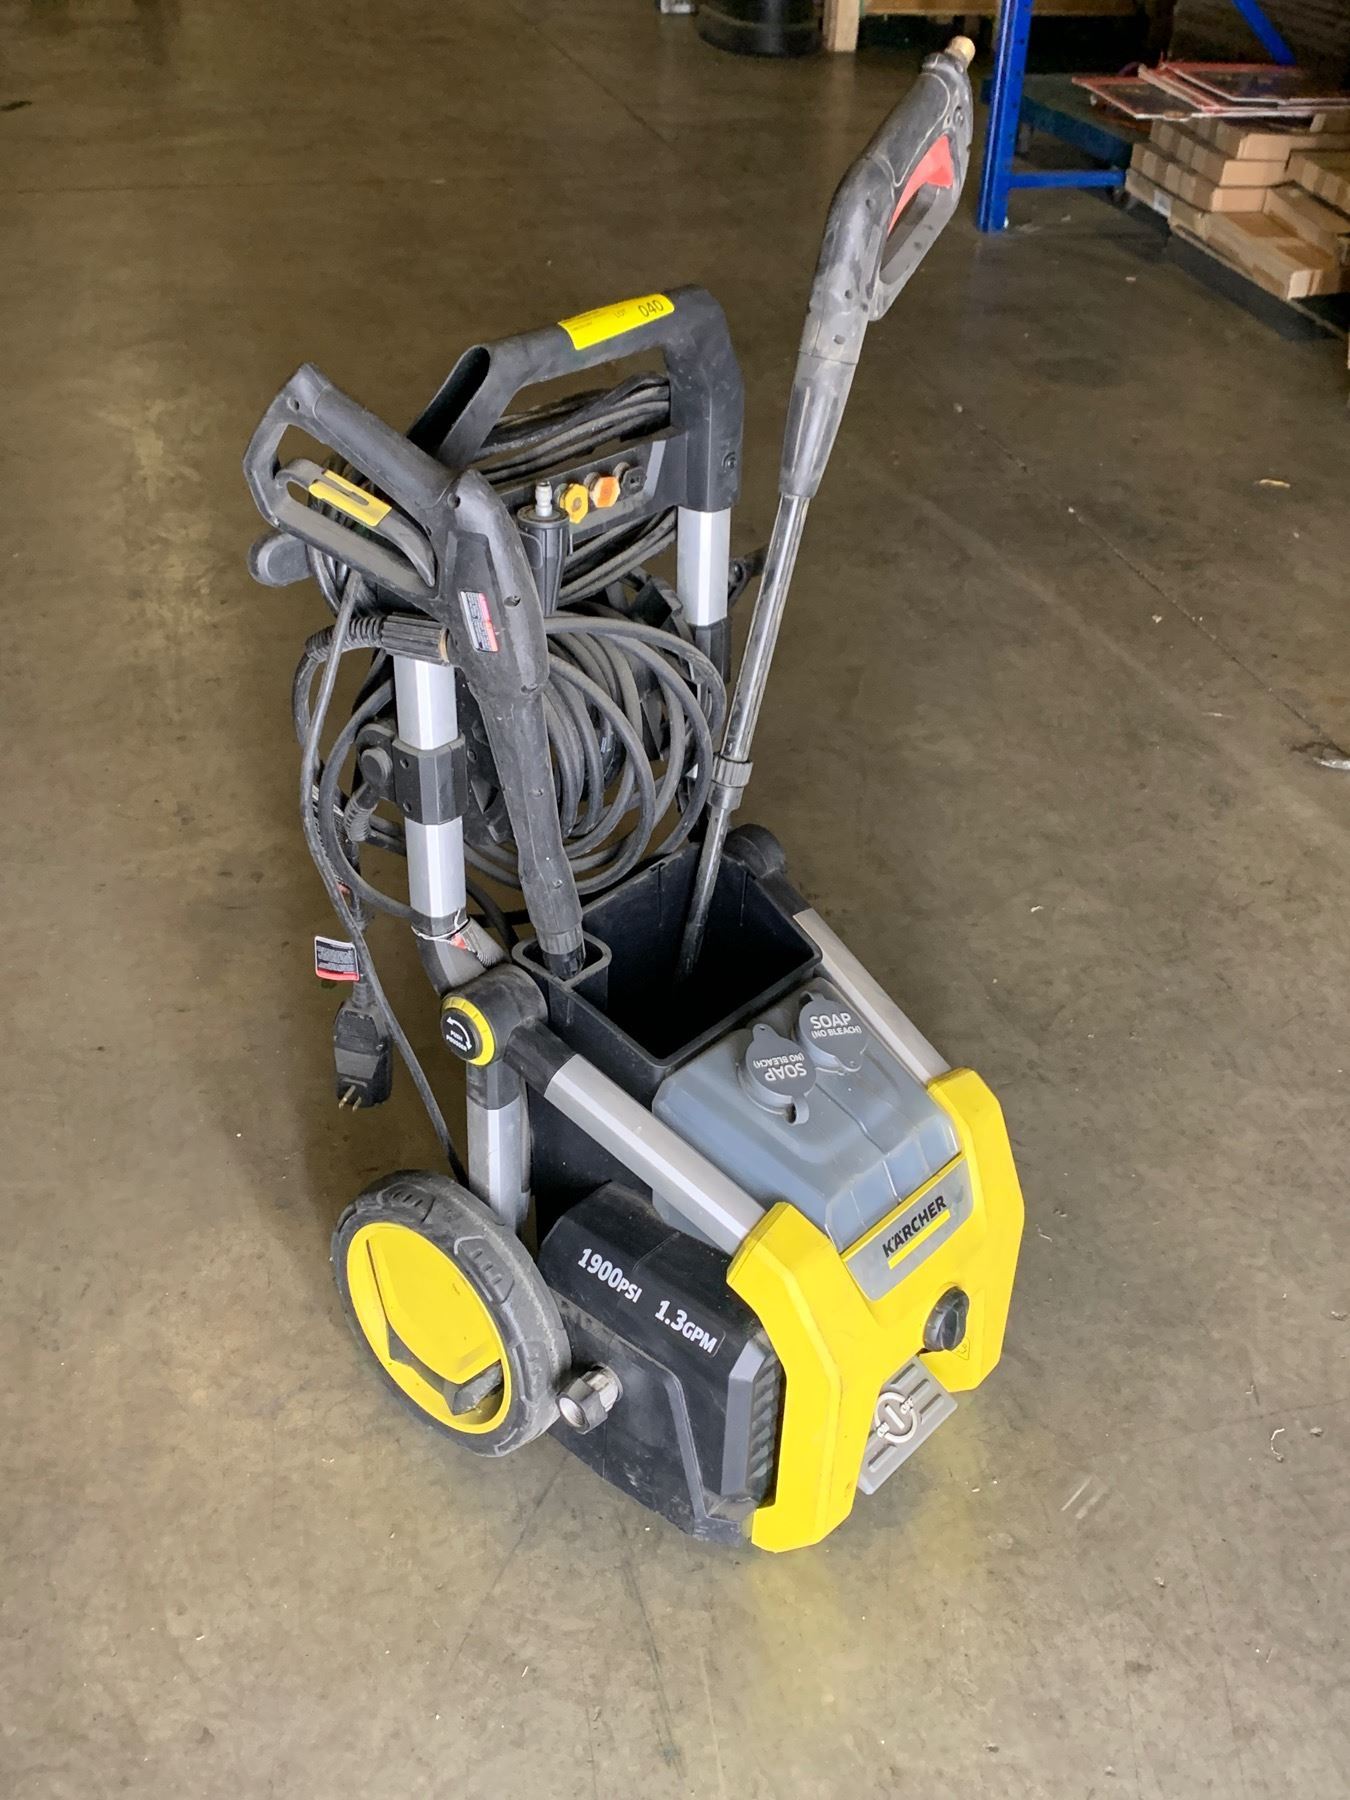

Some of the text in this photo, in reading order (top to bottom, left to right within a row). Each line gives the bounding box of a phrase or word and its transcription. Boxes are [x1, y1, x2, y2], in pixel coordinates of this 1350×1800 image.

[638, 299, 664, 317] 040
[809, 1012, 852, 1029] SOAP
[811, 1025, 862, 1039] (NO BLEACH)
[753, 1052, 805, 1068] (NO BLEACH)
[764, 1063, 807, 1081] SOAP
[882, 1195, 947, 1258] KÄRCHER
[577, 1248, 643, 1304] 1900PSI
[654, 1300, 718, 1354] 1.3GPM
